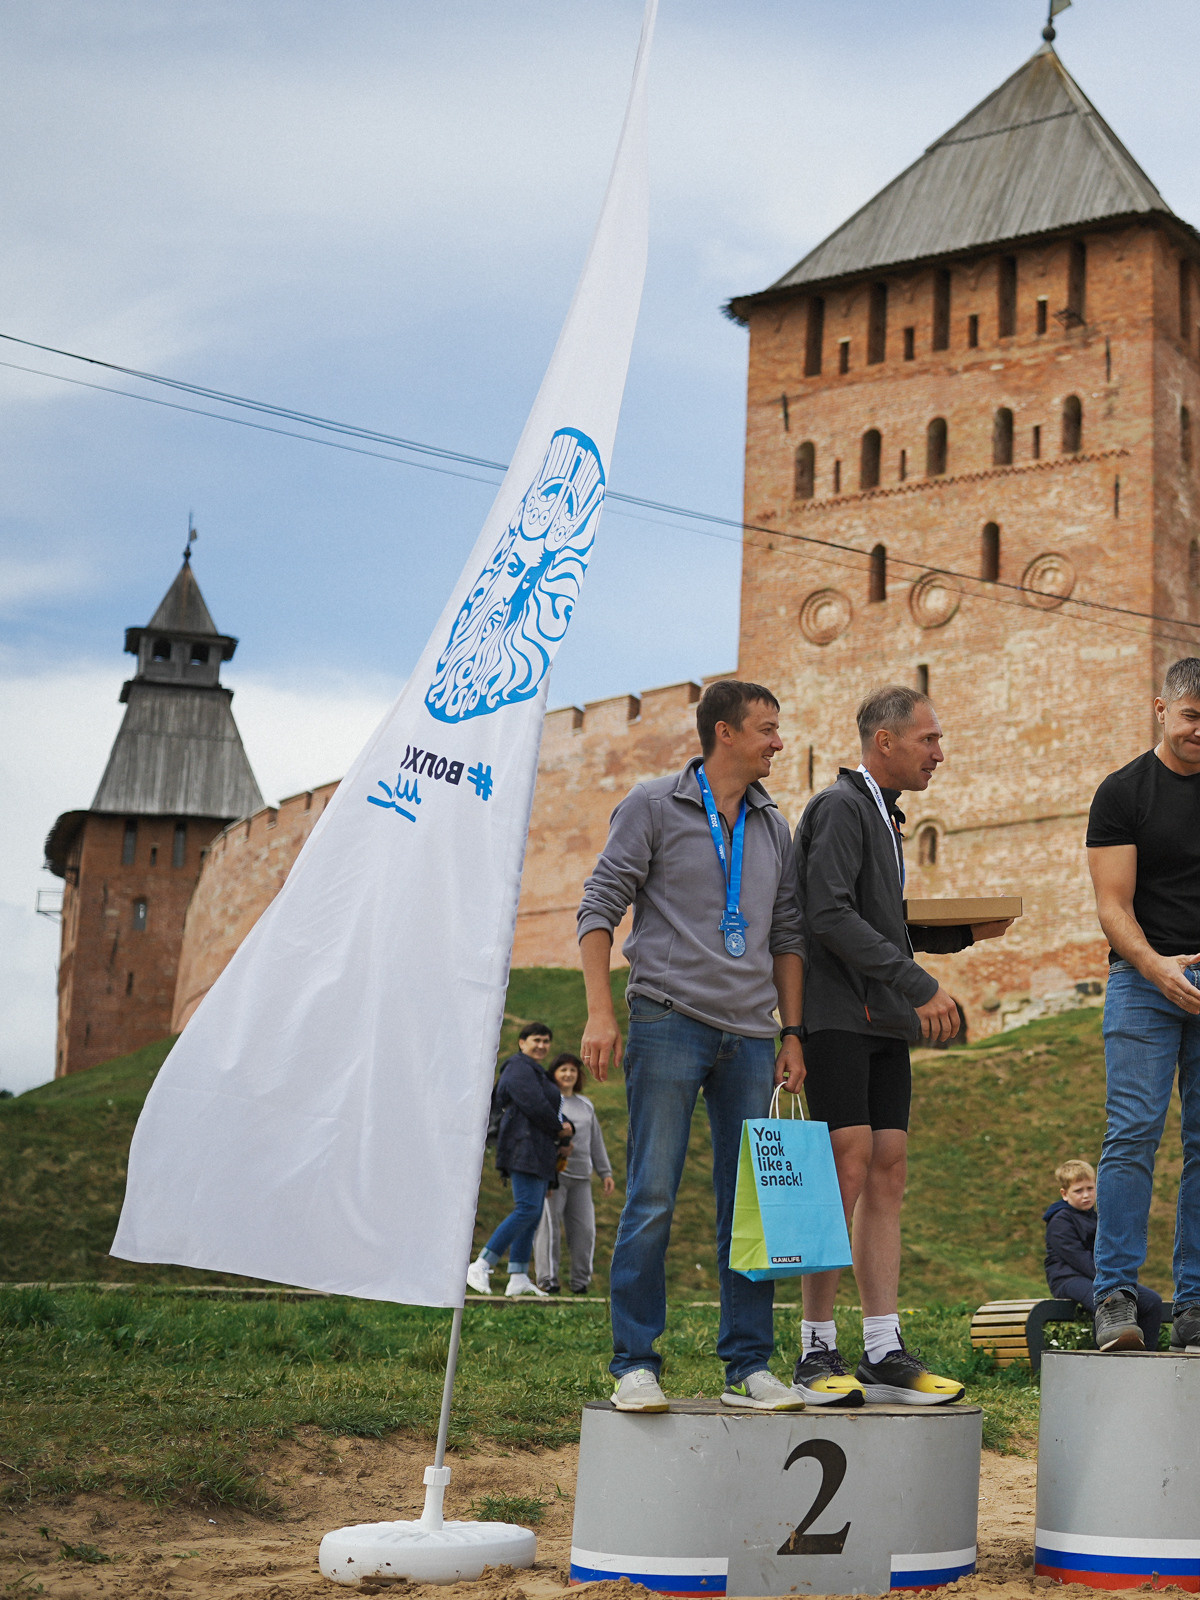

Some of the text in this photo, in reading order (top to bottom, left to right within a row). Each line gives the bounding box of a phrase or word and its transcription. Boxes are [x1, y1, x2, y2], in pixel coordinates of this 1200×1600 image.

[753, 1127, 781, 1142] You
[756, 1142, 785, 1157] look
[757, 1157, 793, 1171] like a
[760, 1172, 803, 1187] snack!
[777, 1438, 852, 1556] 2
